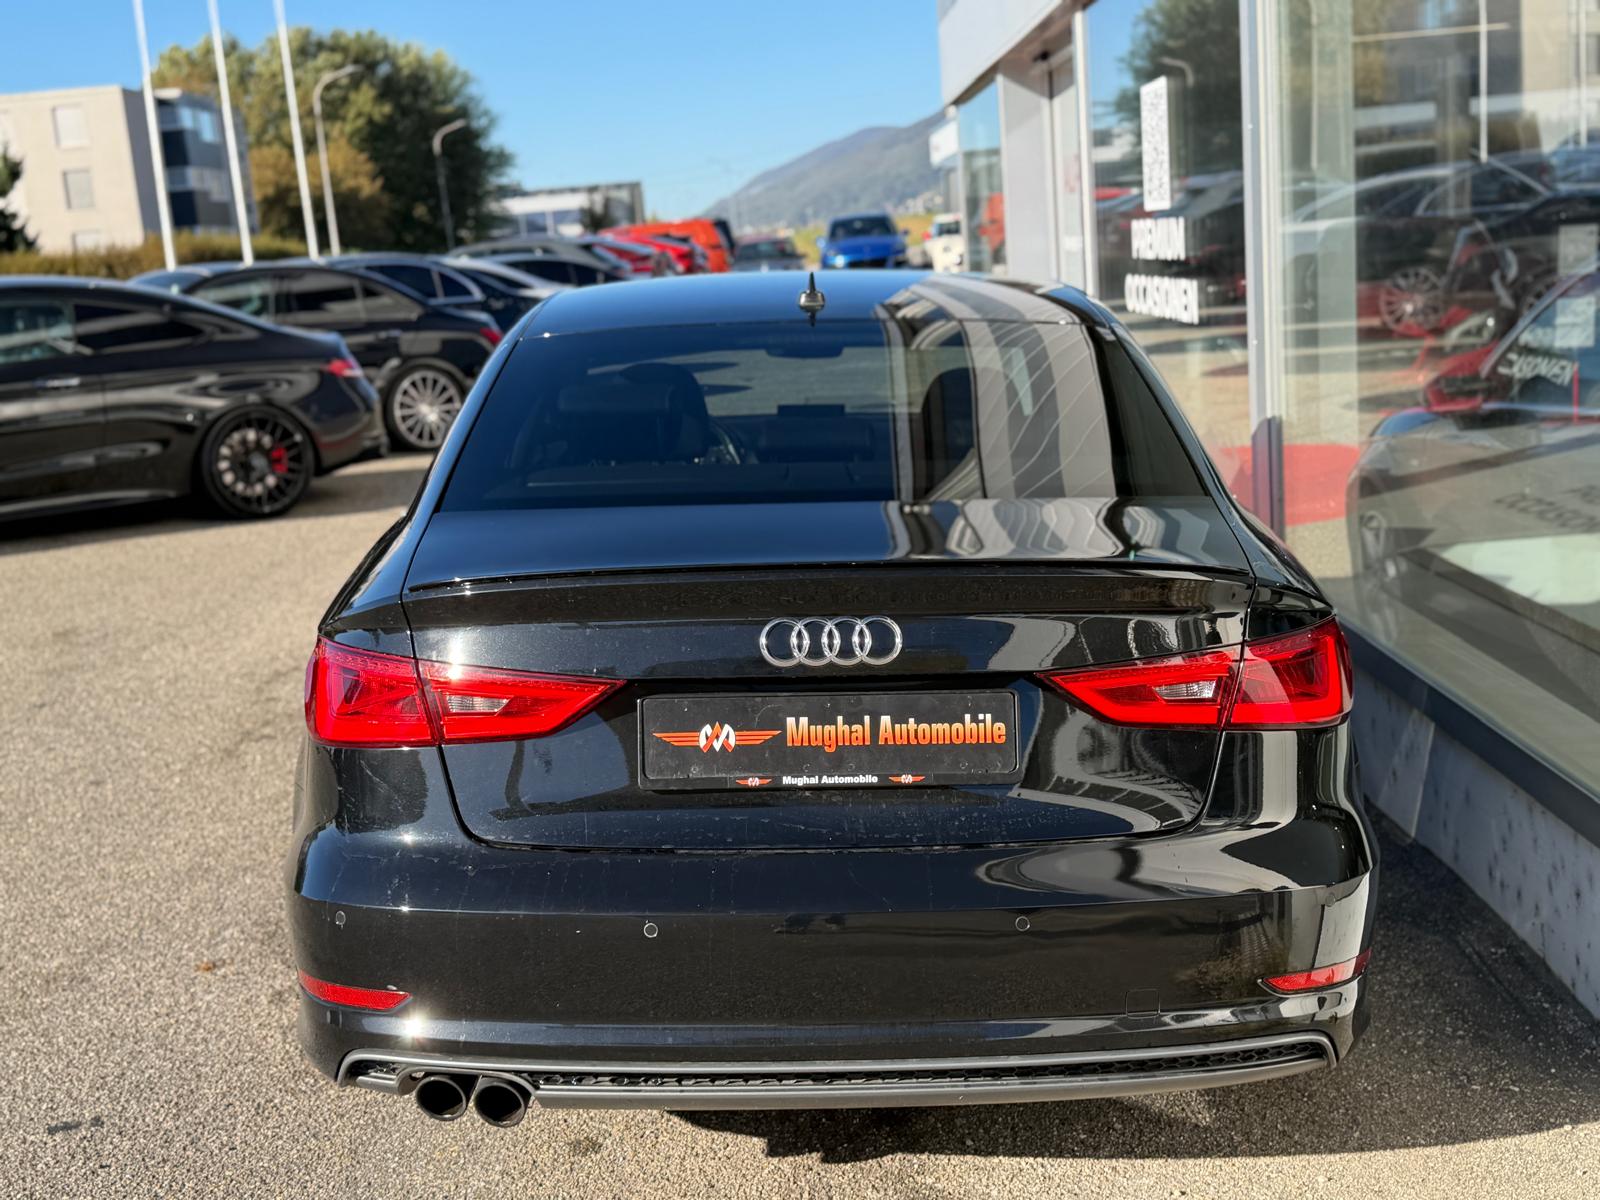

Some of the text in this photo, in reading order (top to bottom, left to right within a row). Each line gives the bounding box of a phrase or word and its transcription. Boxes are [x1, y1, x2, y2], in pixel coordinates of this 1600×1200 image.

[786, 713, 1006, 753] Mughal Automobile
[782, 774, 879, 786] Mughal Automobile
